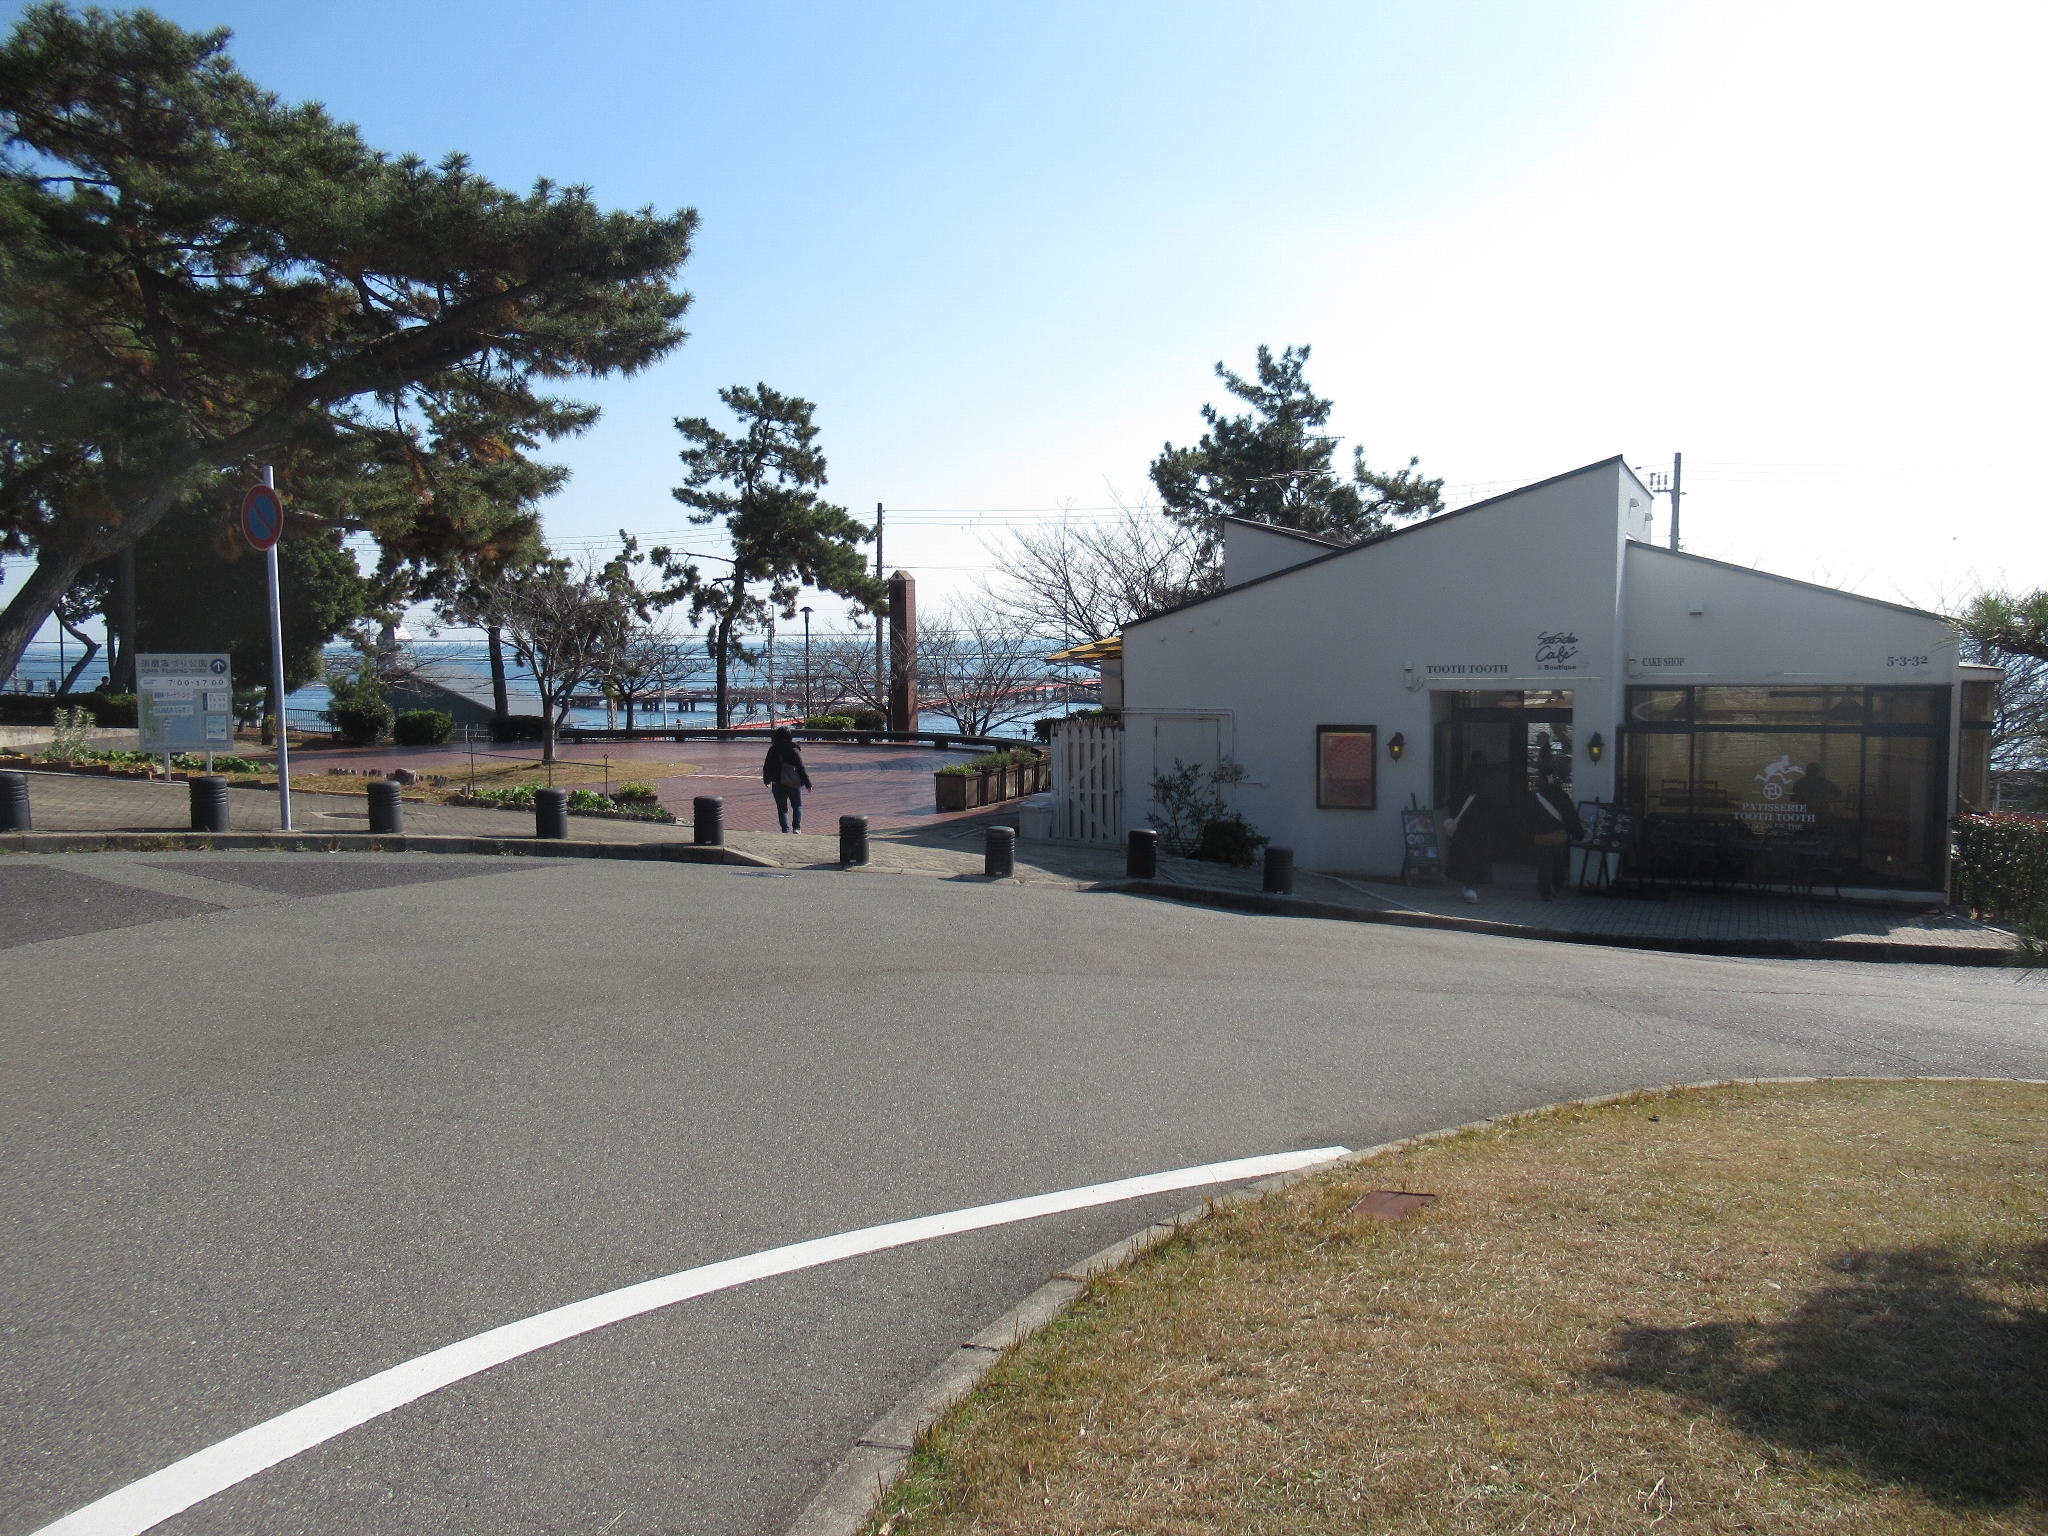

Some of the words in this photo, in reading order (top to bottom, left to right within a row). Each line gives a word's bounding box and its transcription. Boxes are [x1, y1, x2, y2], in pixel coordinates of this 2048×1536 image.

[1536, 645, 1579, 663] Café
[1642, 657, 1661, 666] CAKE
[1663, 657, 1684, 666] SHOP
[1887, 655, 1928, 666] 5-3-32
[1427, 665, 1466, 674] TOOTH
[1469, 664, 1508, 673] TOOTH
[1742, 803, 1808, 813] PATISSERIE
[1734, 812, 1773, 821] TOOTH
[1775, 813, 1816, 823] TOOTH
